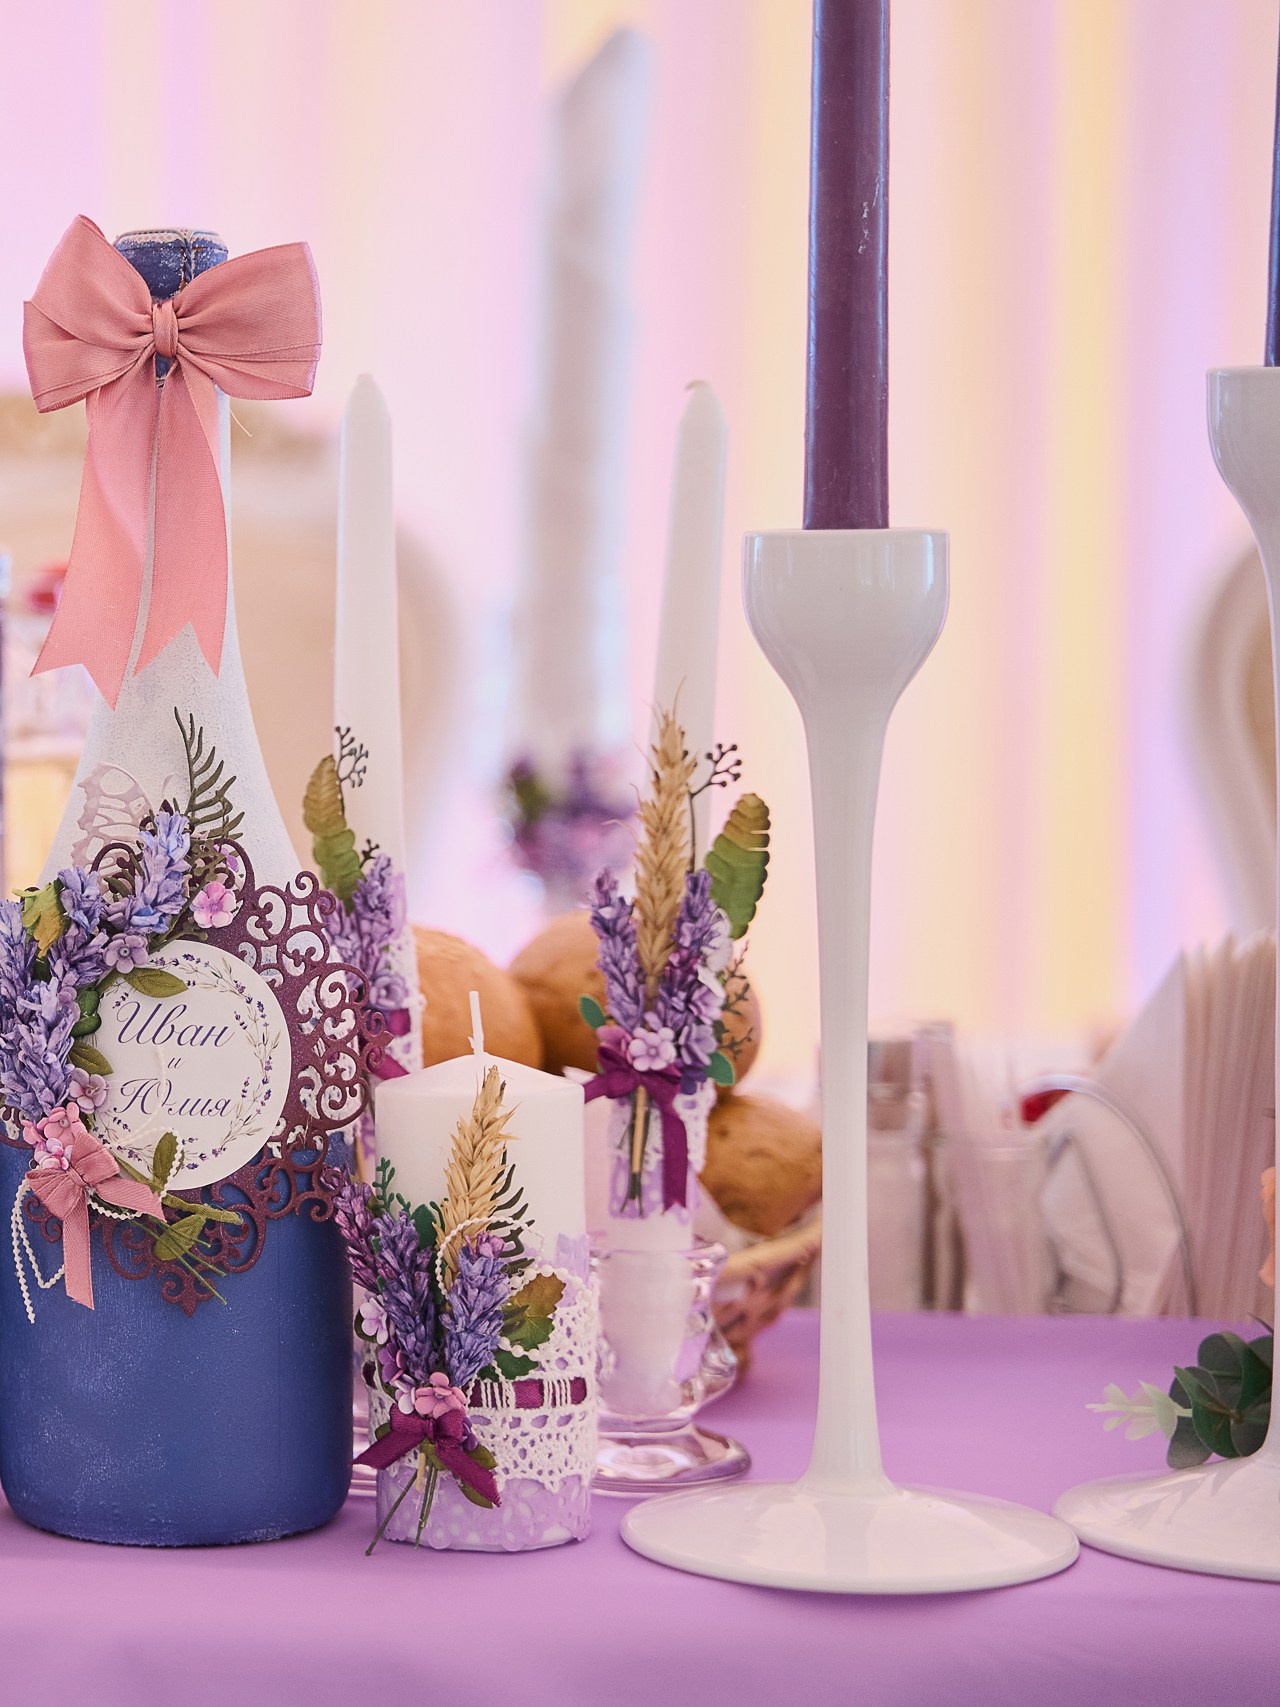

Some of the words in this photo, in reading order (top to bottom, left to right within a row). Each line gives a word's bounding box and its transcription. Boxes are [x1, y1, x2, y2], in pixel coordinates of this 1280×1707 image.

[116, 1001, 235, 1047] Иван
[167, 1057, 184, 1069] и
[113, 1078, 235, 1118] Юлия
